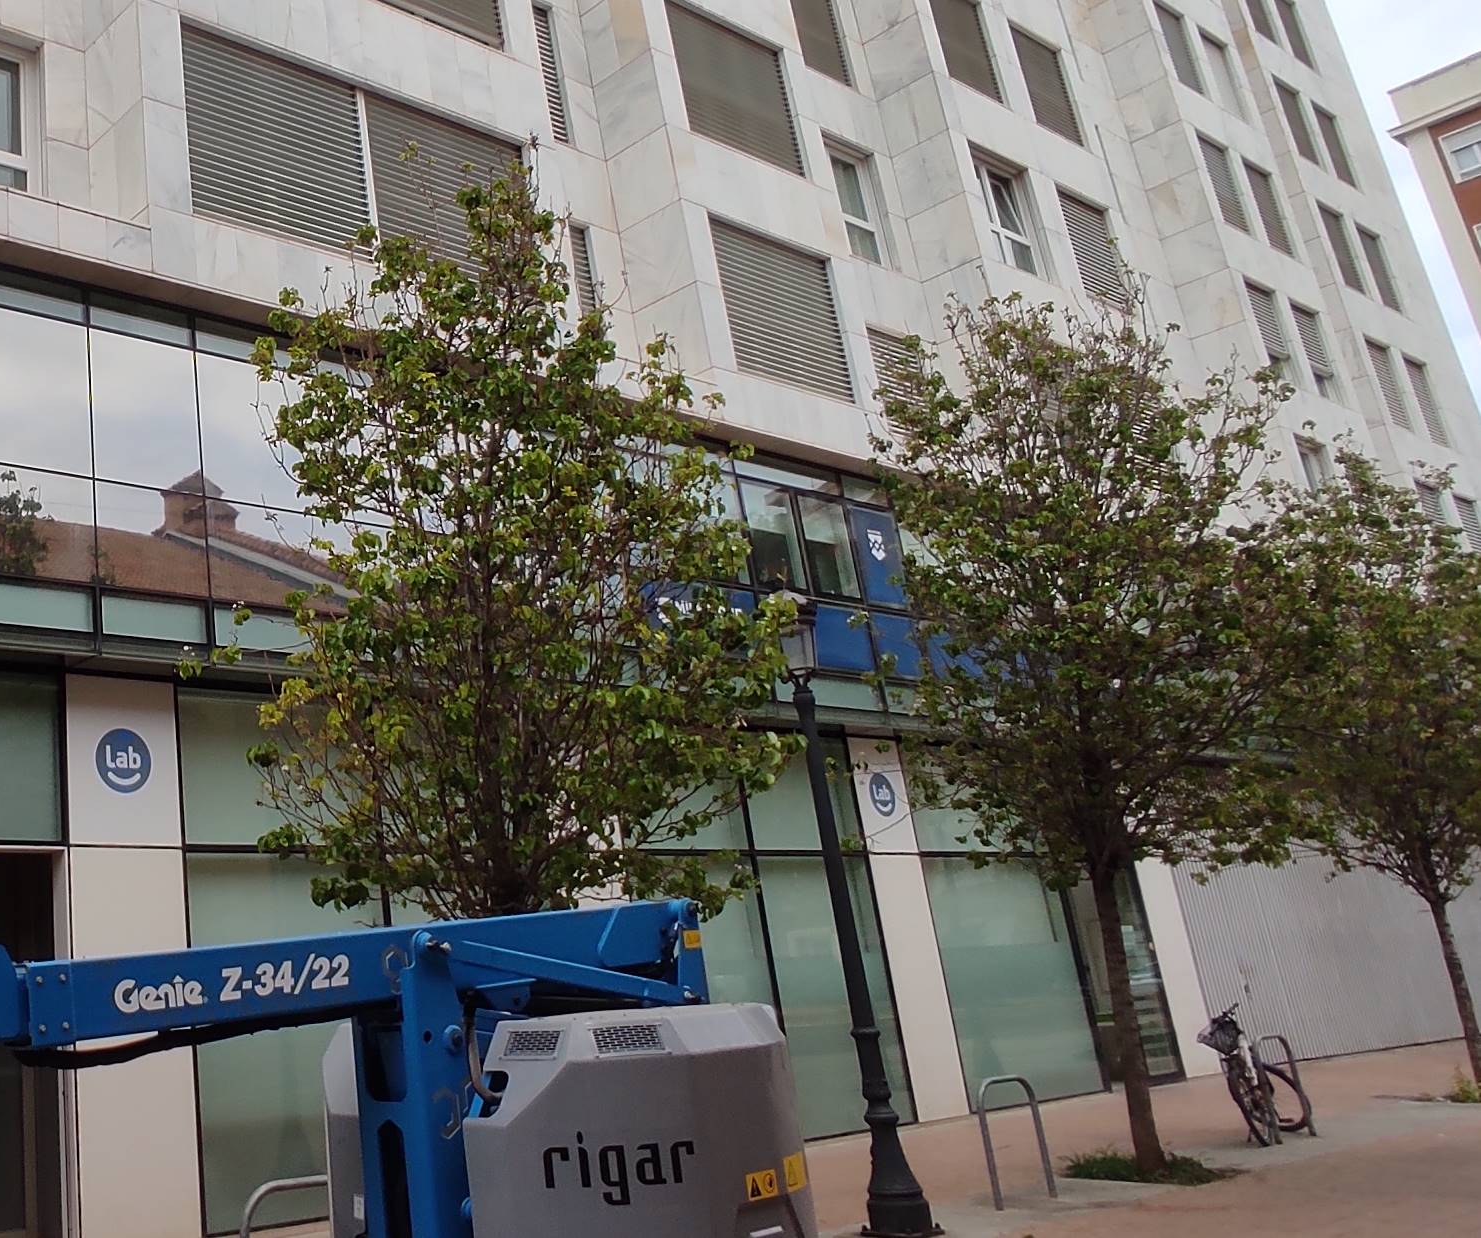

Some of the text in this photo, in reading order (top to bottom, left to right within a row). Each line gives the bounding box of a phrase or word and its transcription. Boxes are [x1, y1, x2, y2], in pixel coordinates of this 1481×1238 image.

[105, 744, 142, 769] Lab
[872, 783, 892, 801] Lab
[114, 953, 350, 1014] Genie Z-34/22
[542, 1131, 695, 1207] rigar
